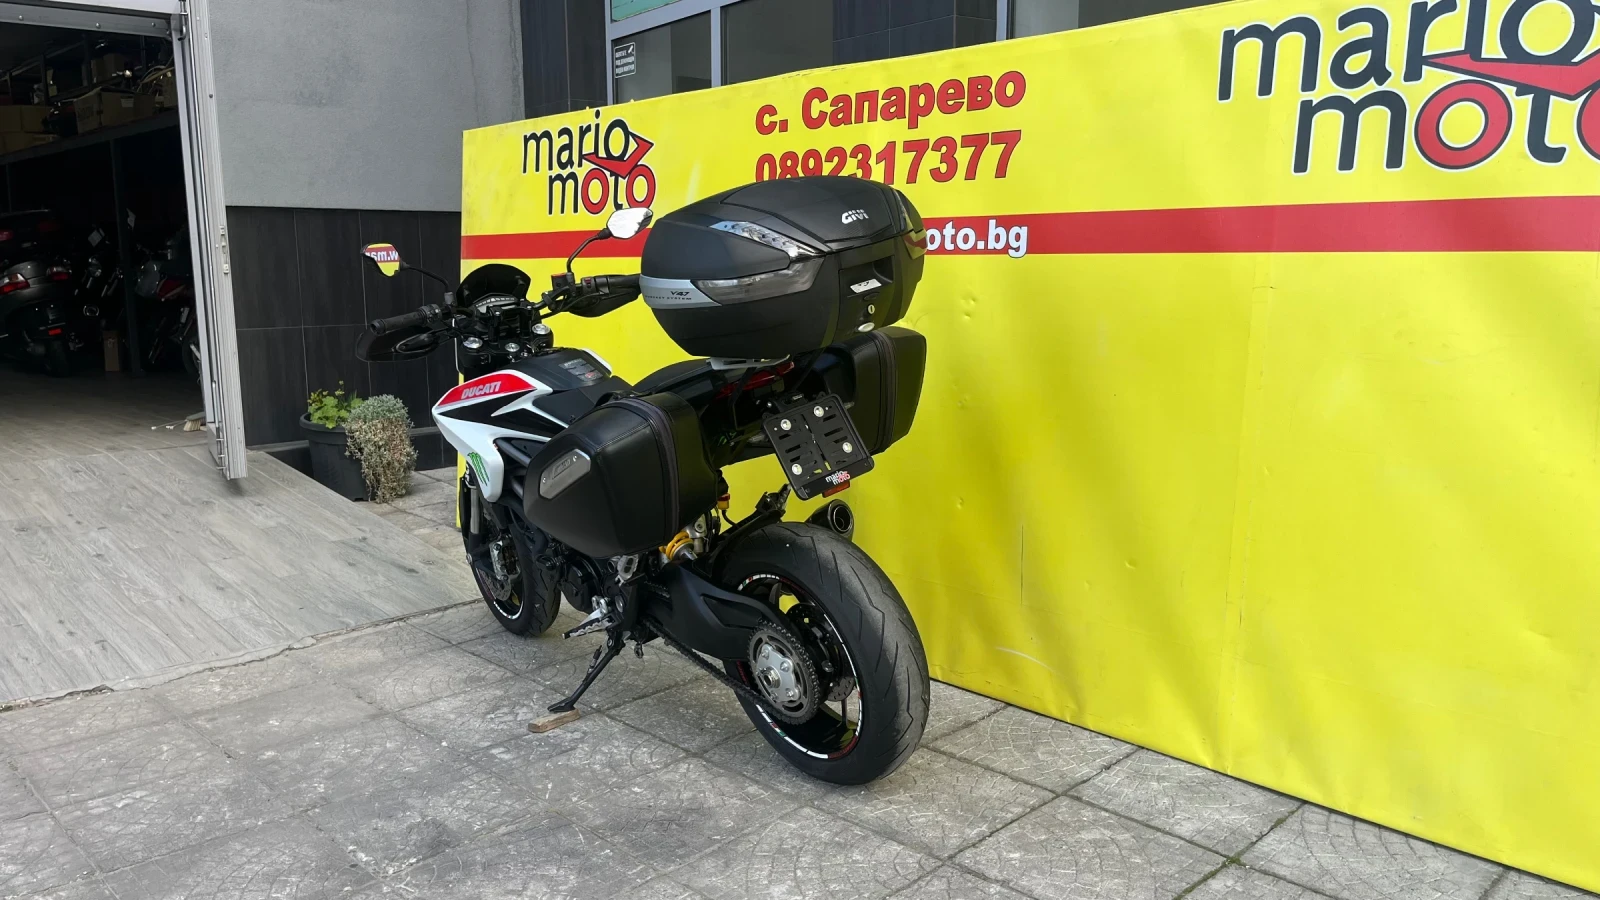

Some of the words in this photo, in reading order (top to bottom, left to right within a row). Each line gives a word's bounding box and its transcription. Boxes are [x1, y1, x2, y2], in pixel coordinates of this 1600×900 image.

[1217, 0, 1588, 101] mario
[801, 70, 1026, 129] Сапарево
[1292, 79, 1600, 174] mot
[522, 109, 630, 174] mario
[755, 129, 1021, 185] 0892317377
[548, 164, 656, 215] moto
[841, 208, 869, 225] GIVI
[925, 219, 1029, 258] oto.bg
[460, 380, 502, 400] DUCATI
